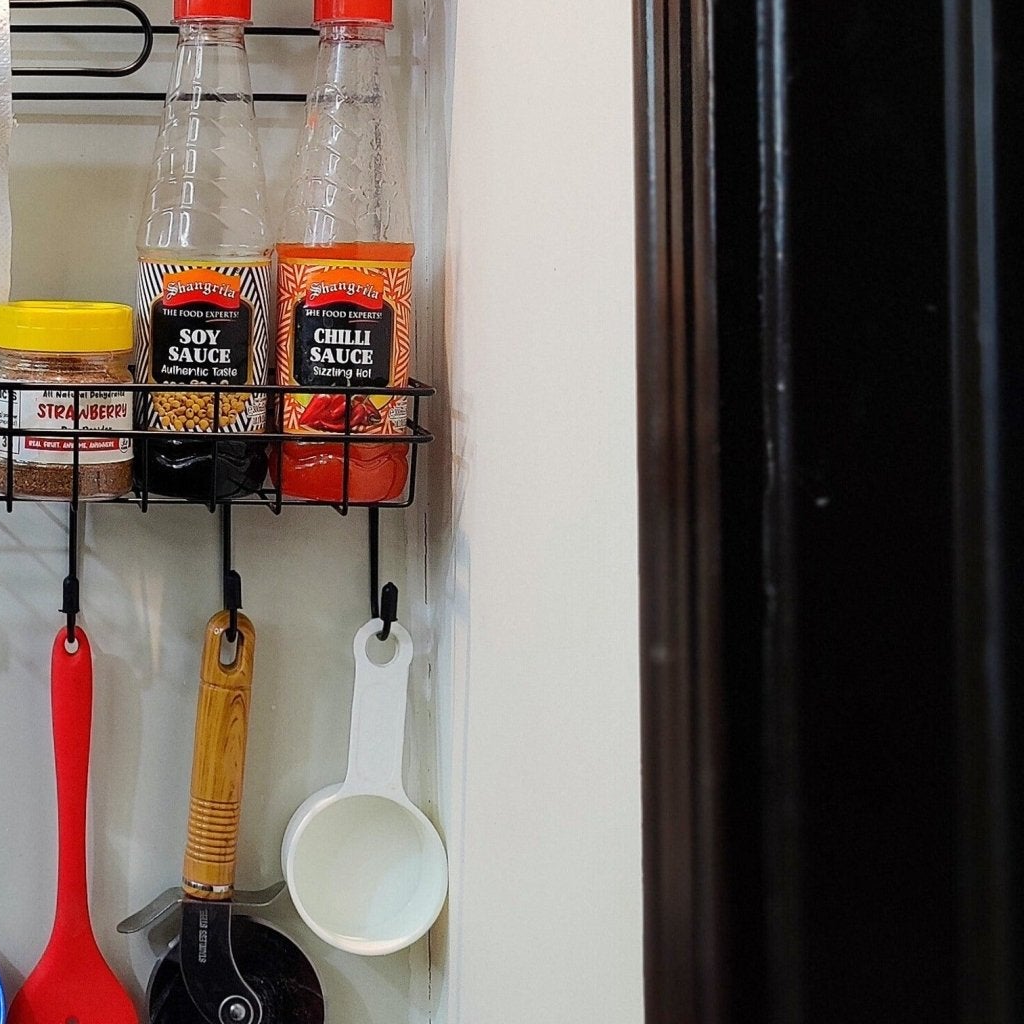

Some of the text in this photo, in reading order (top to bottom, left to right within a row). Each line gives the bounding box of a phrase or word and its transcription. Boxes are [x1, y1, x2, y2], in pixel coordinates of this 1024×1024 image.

[166, 280, 236, 300] Shangrila
[309, 280, 378, 301] Shangrila
[163, 308, 177, 316] THE
[179, 309, 204, 318] FOOD
[304, 308, 320, 317] THE
[322, 309, 347, 318] FOOD
[179, 328, 221, 345] SOY
[313, 328, 371, 346] CHILLI
[168, 346, 231, 364] SAUCE
[310, 347, 374, 365] SAUCE
[161, 364, 238, 377] Authentic Taste
[313, 365, 353, 379] Sizzling
[37, 403, 127, 421] STRAWBERRY
